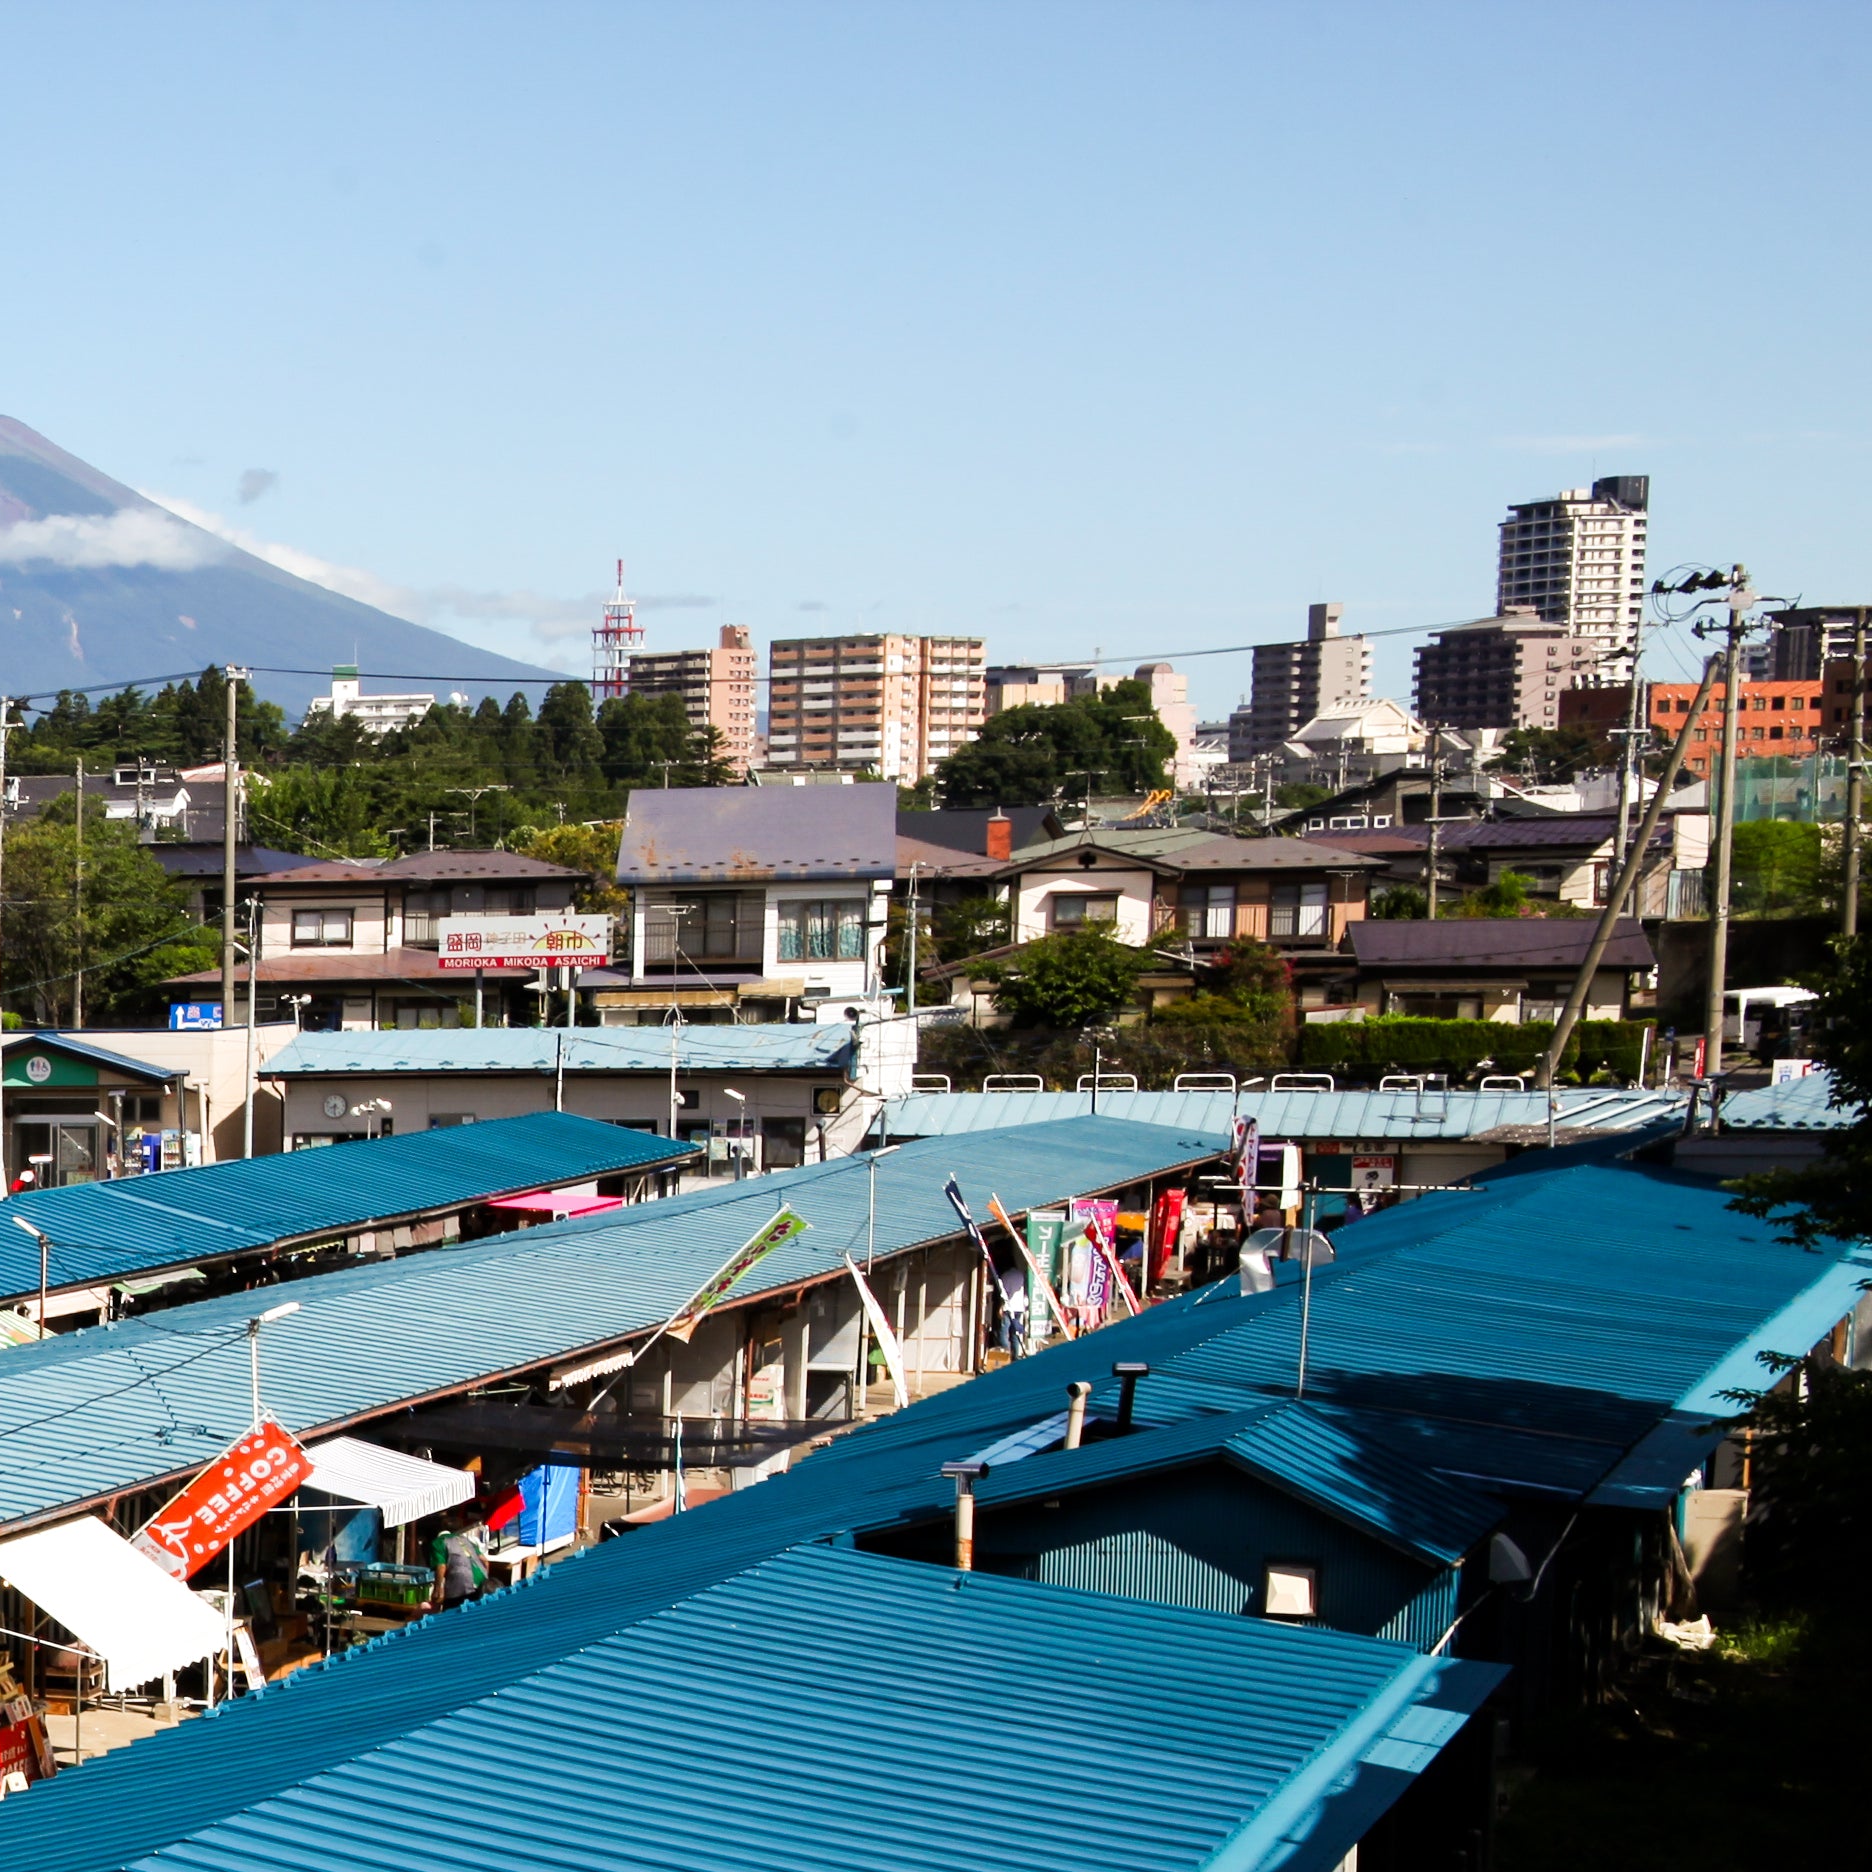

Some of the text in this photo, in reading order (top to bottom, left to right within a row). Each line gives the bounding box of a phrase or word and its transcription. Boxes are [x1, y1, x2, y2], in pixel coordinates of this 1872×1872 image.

[447, 933, 482, 951] 盛岡
[546, 930, 583, 951] 朝市
[444, 956, 601, 968] MORIOKA MIKODA ASAICHI
